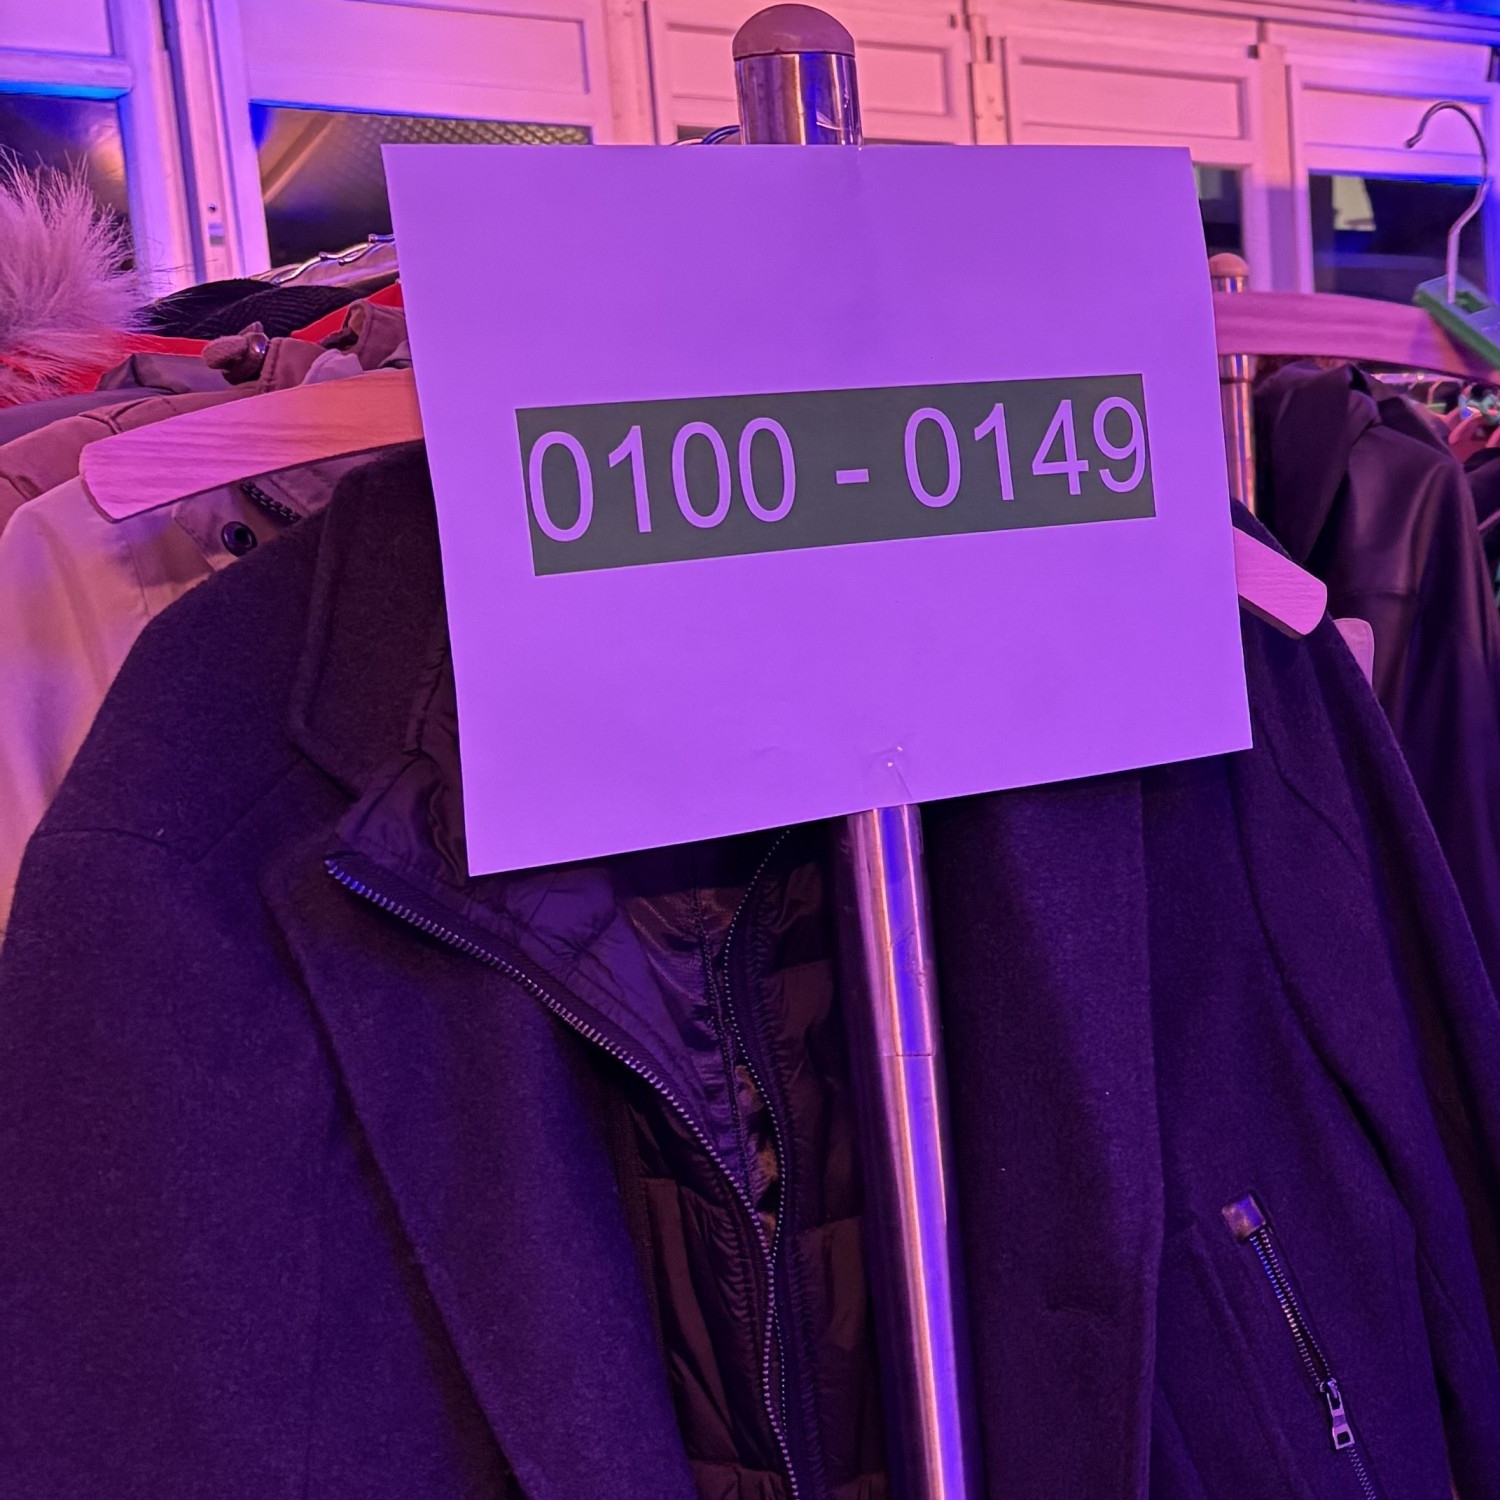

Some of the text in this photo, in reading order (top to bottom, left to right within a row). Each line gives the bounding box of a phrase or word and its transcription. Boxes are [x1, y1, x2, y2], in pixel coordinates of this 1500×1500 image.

[529, 396, 1146, 541] 0100 - 0149
